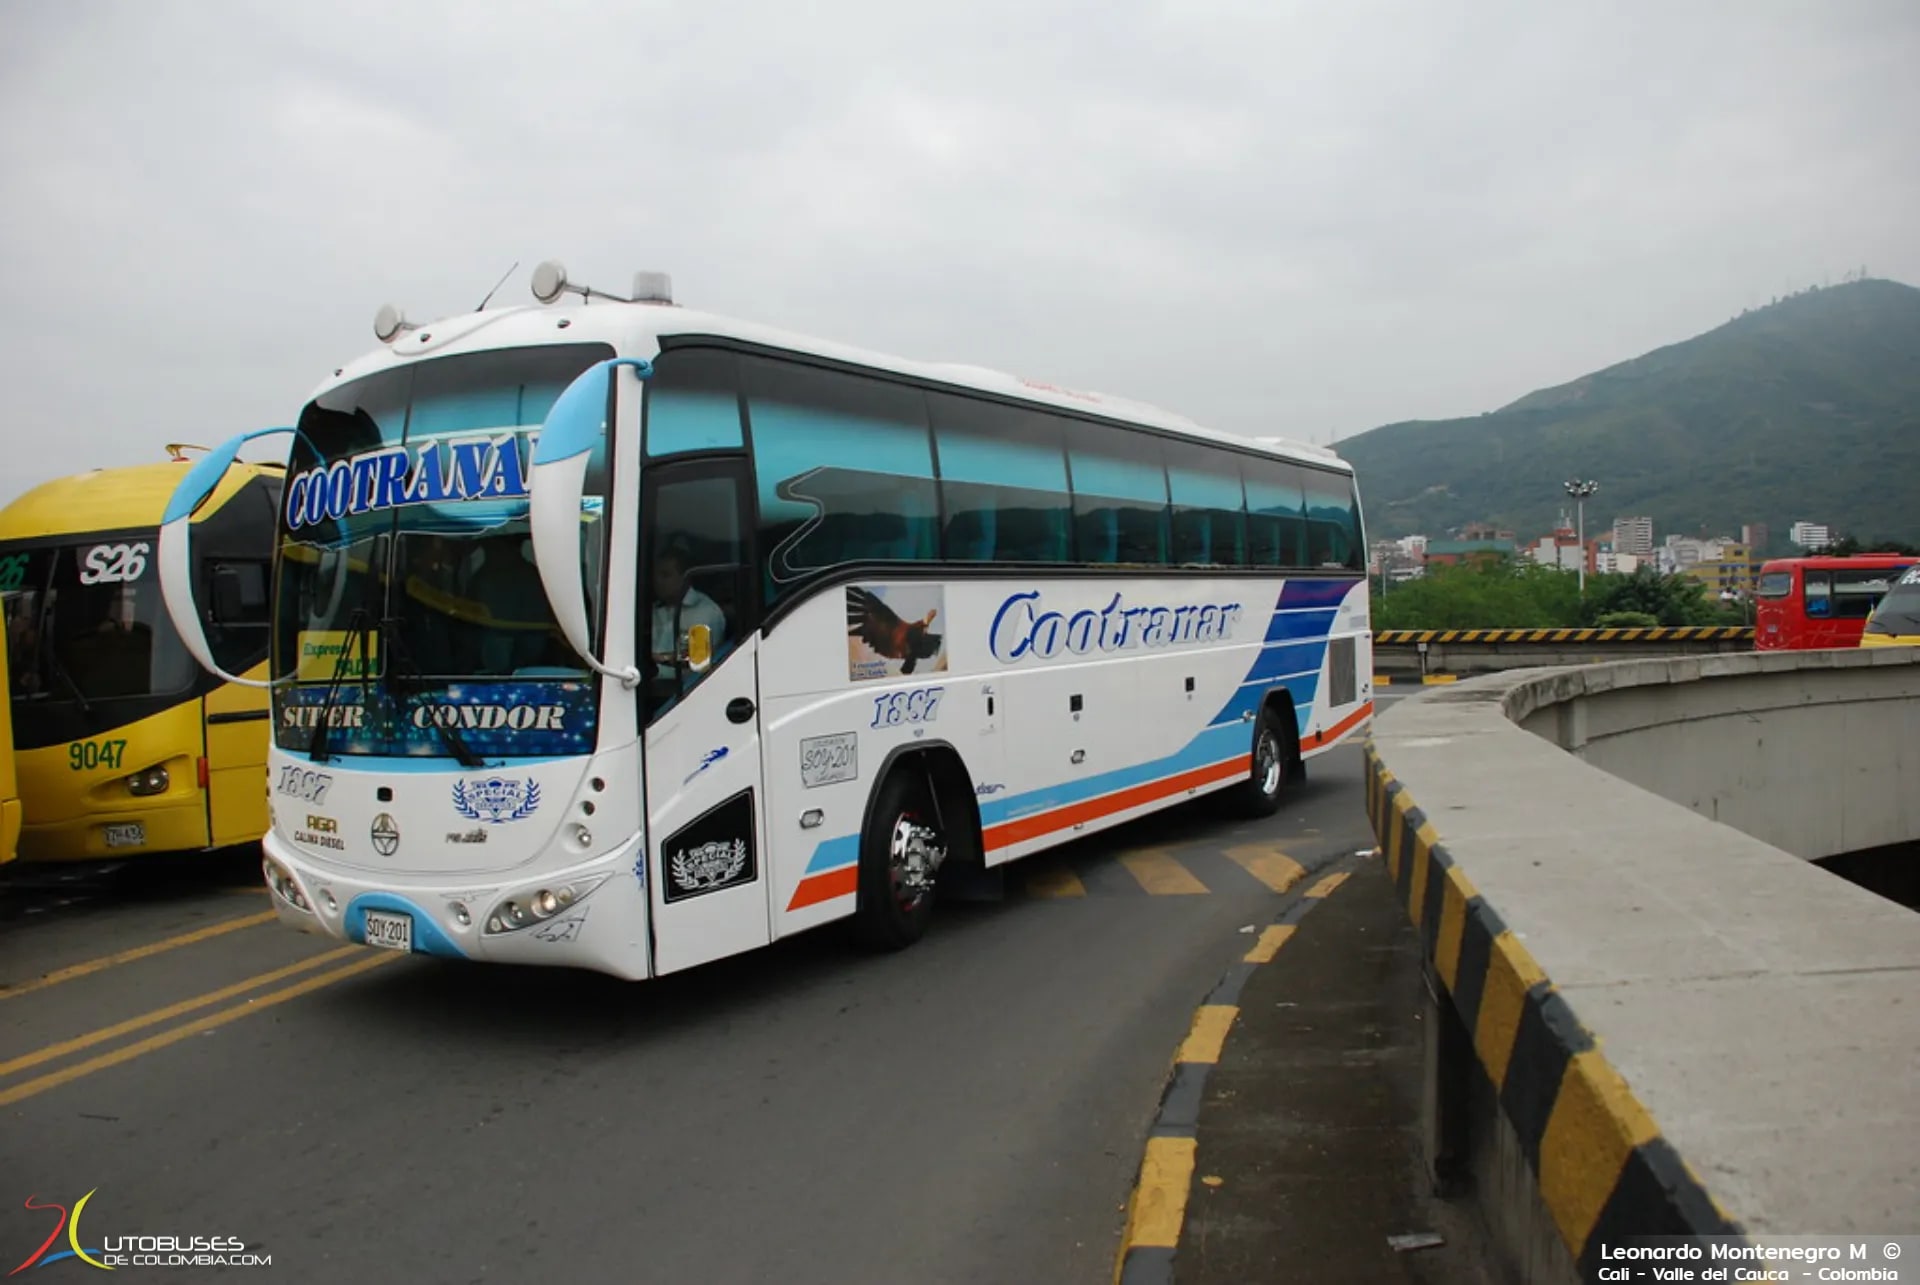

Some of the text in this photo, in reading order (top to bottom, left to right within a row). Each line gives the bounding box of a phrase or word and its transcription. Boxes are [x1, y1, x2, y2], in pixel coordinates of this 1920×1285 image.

[287, 432, 542, 529] COOTRANA
[80, 543, 150, 585] S26
[989, 590, 1241, 664] Cootranar
[413, 704, 566, 729] CONDOR
[69, 739, 127, 771] 9047
[367, 917, 408, 942] SOY-201
